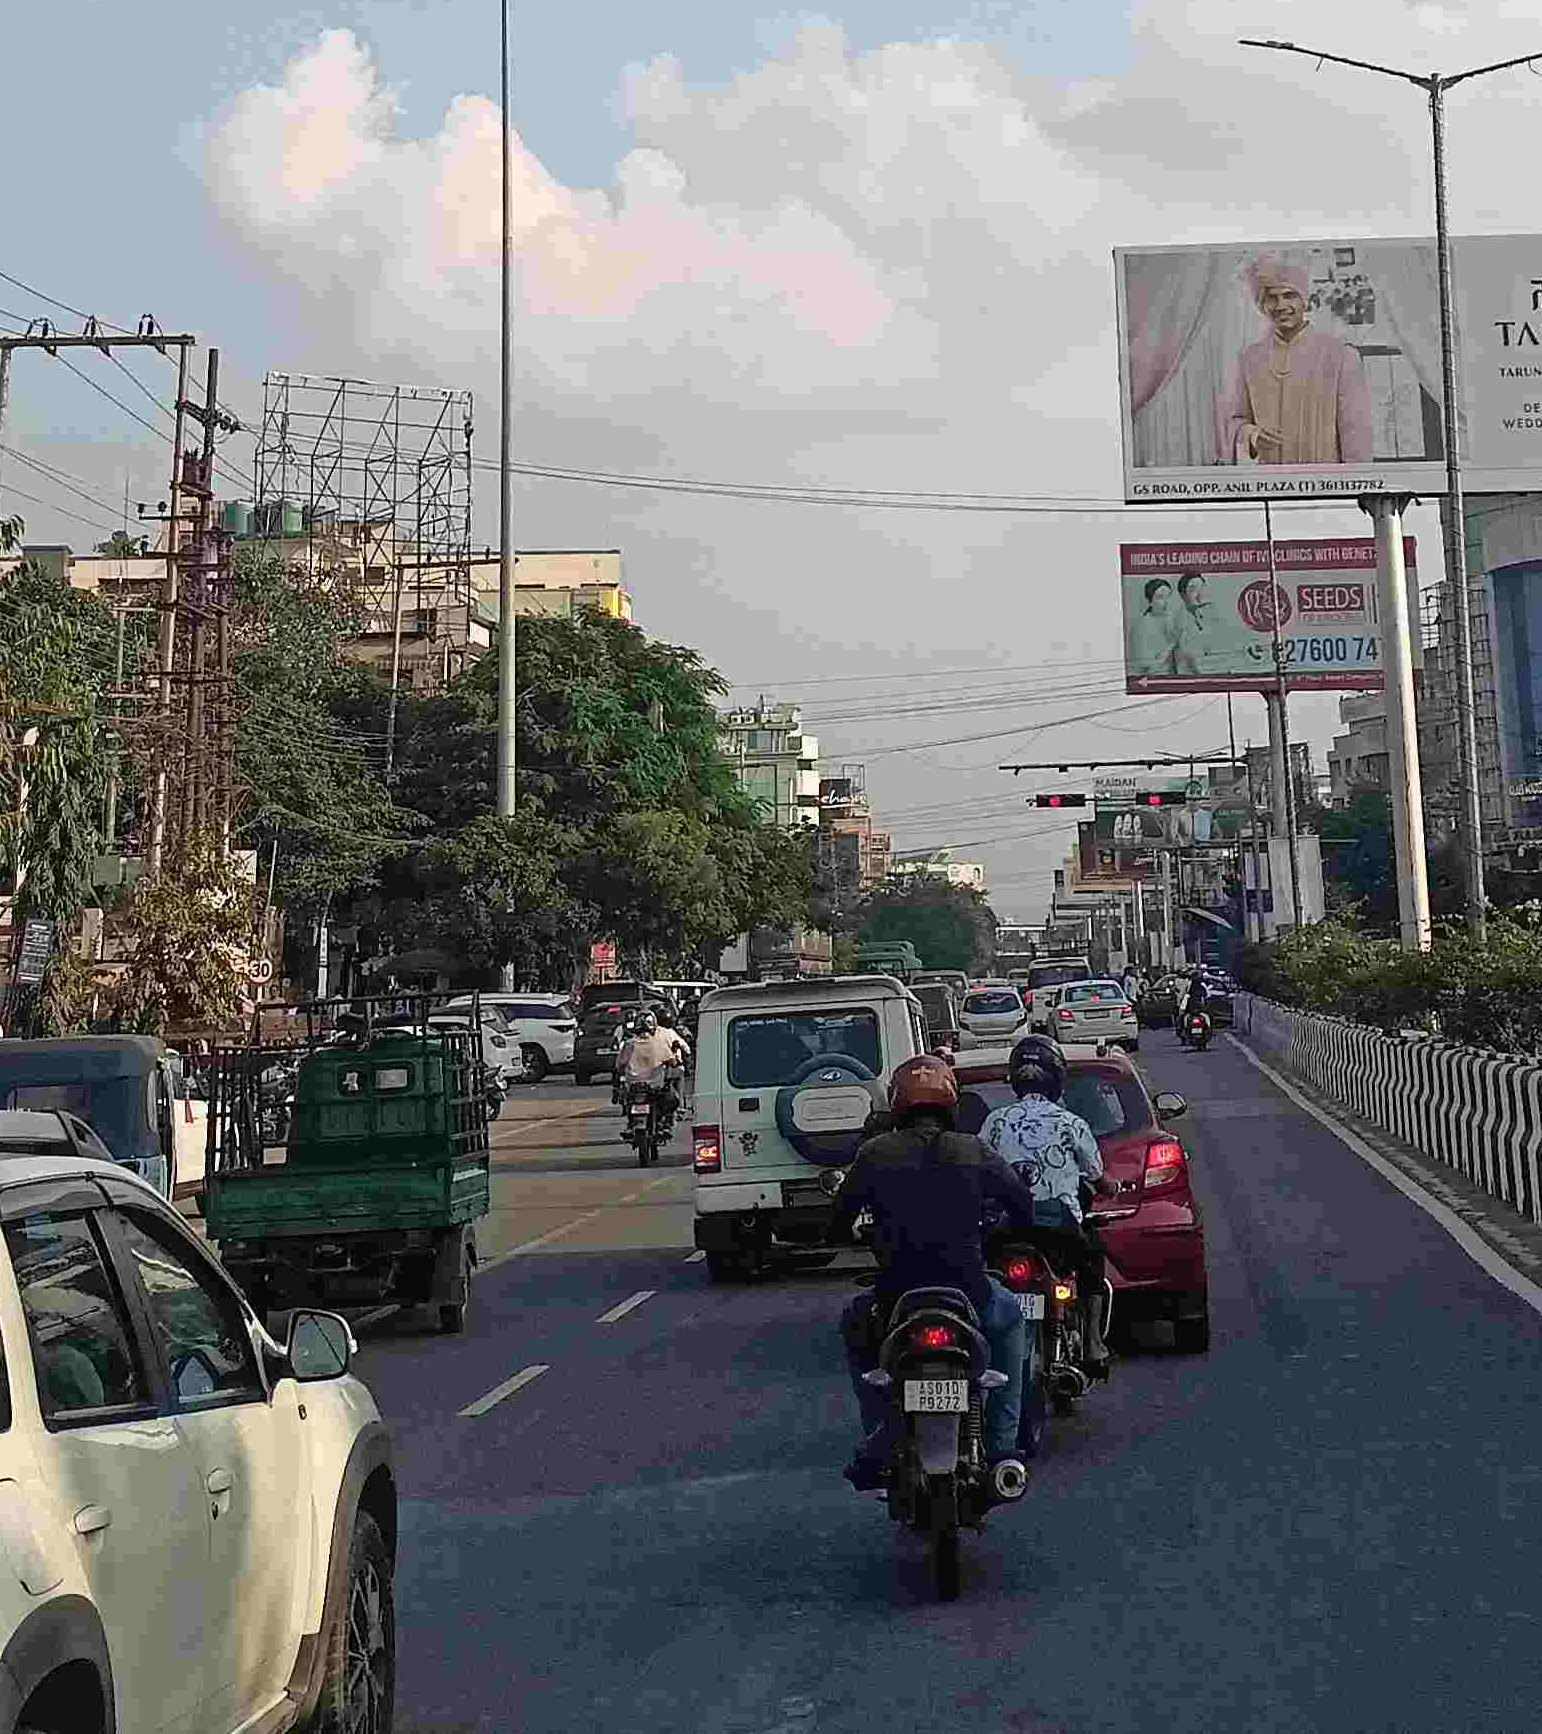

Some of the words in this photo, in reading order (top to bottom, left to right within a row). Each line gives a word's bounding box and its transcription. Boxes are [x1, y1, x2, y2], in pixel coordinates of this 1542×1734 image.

[1133, 483, 1150, 496] GS
[1152, 482, 1191, 496] ROAD,
[1193, 481, 1222, 495] OPP.
[1224, 480, 1253, 493] ANIL
[1257, 479, 1295, 492] PLAZA
[1130, 551, 1165, 566] INDIA'S
[1166, 550, 1210, 565] LEADING
[1210, 549, 1241, 564] CHAIN
[1275, 547, 1313, 562] CLINICS
[1314, 545, 1339, 561] WITH
[1300, 586, 1361, 611] SEEDS
[250, 961, 269, 979] 30
